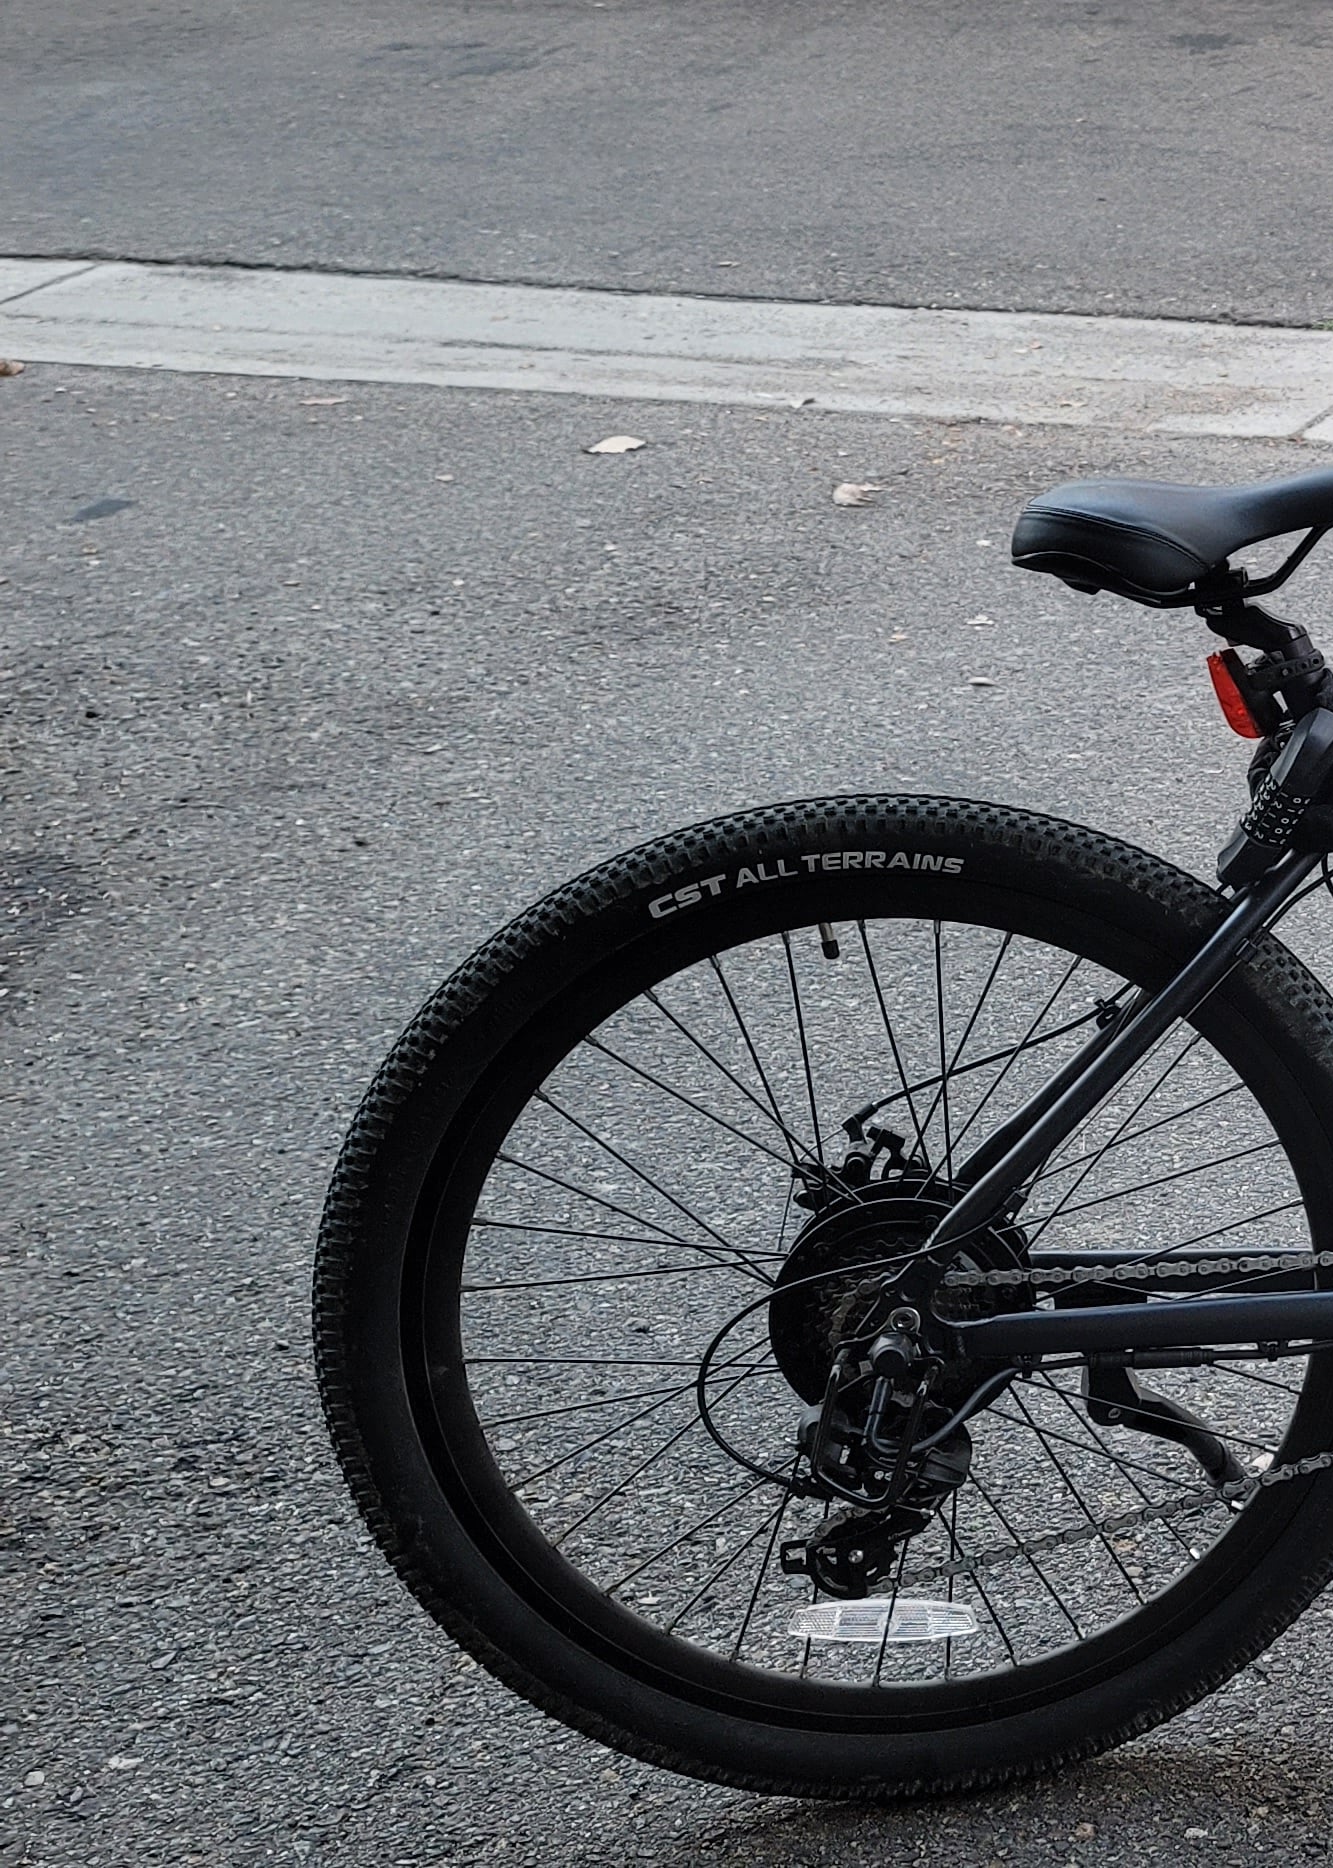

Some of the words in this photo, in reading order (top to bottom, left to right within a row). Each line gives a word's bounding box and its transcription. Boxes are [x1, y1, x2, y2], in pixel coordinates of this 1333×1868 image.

[648, 874, 726, 919] CST
[736, 859, 798, 889] ALL
[801, 851, 965, 874] TERRAINS
